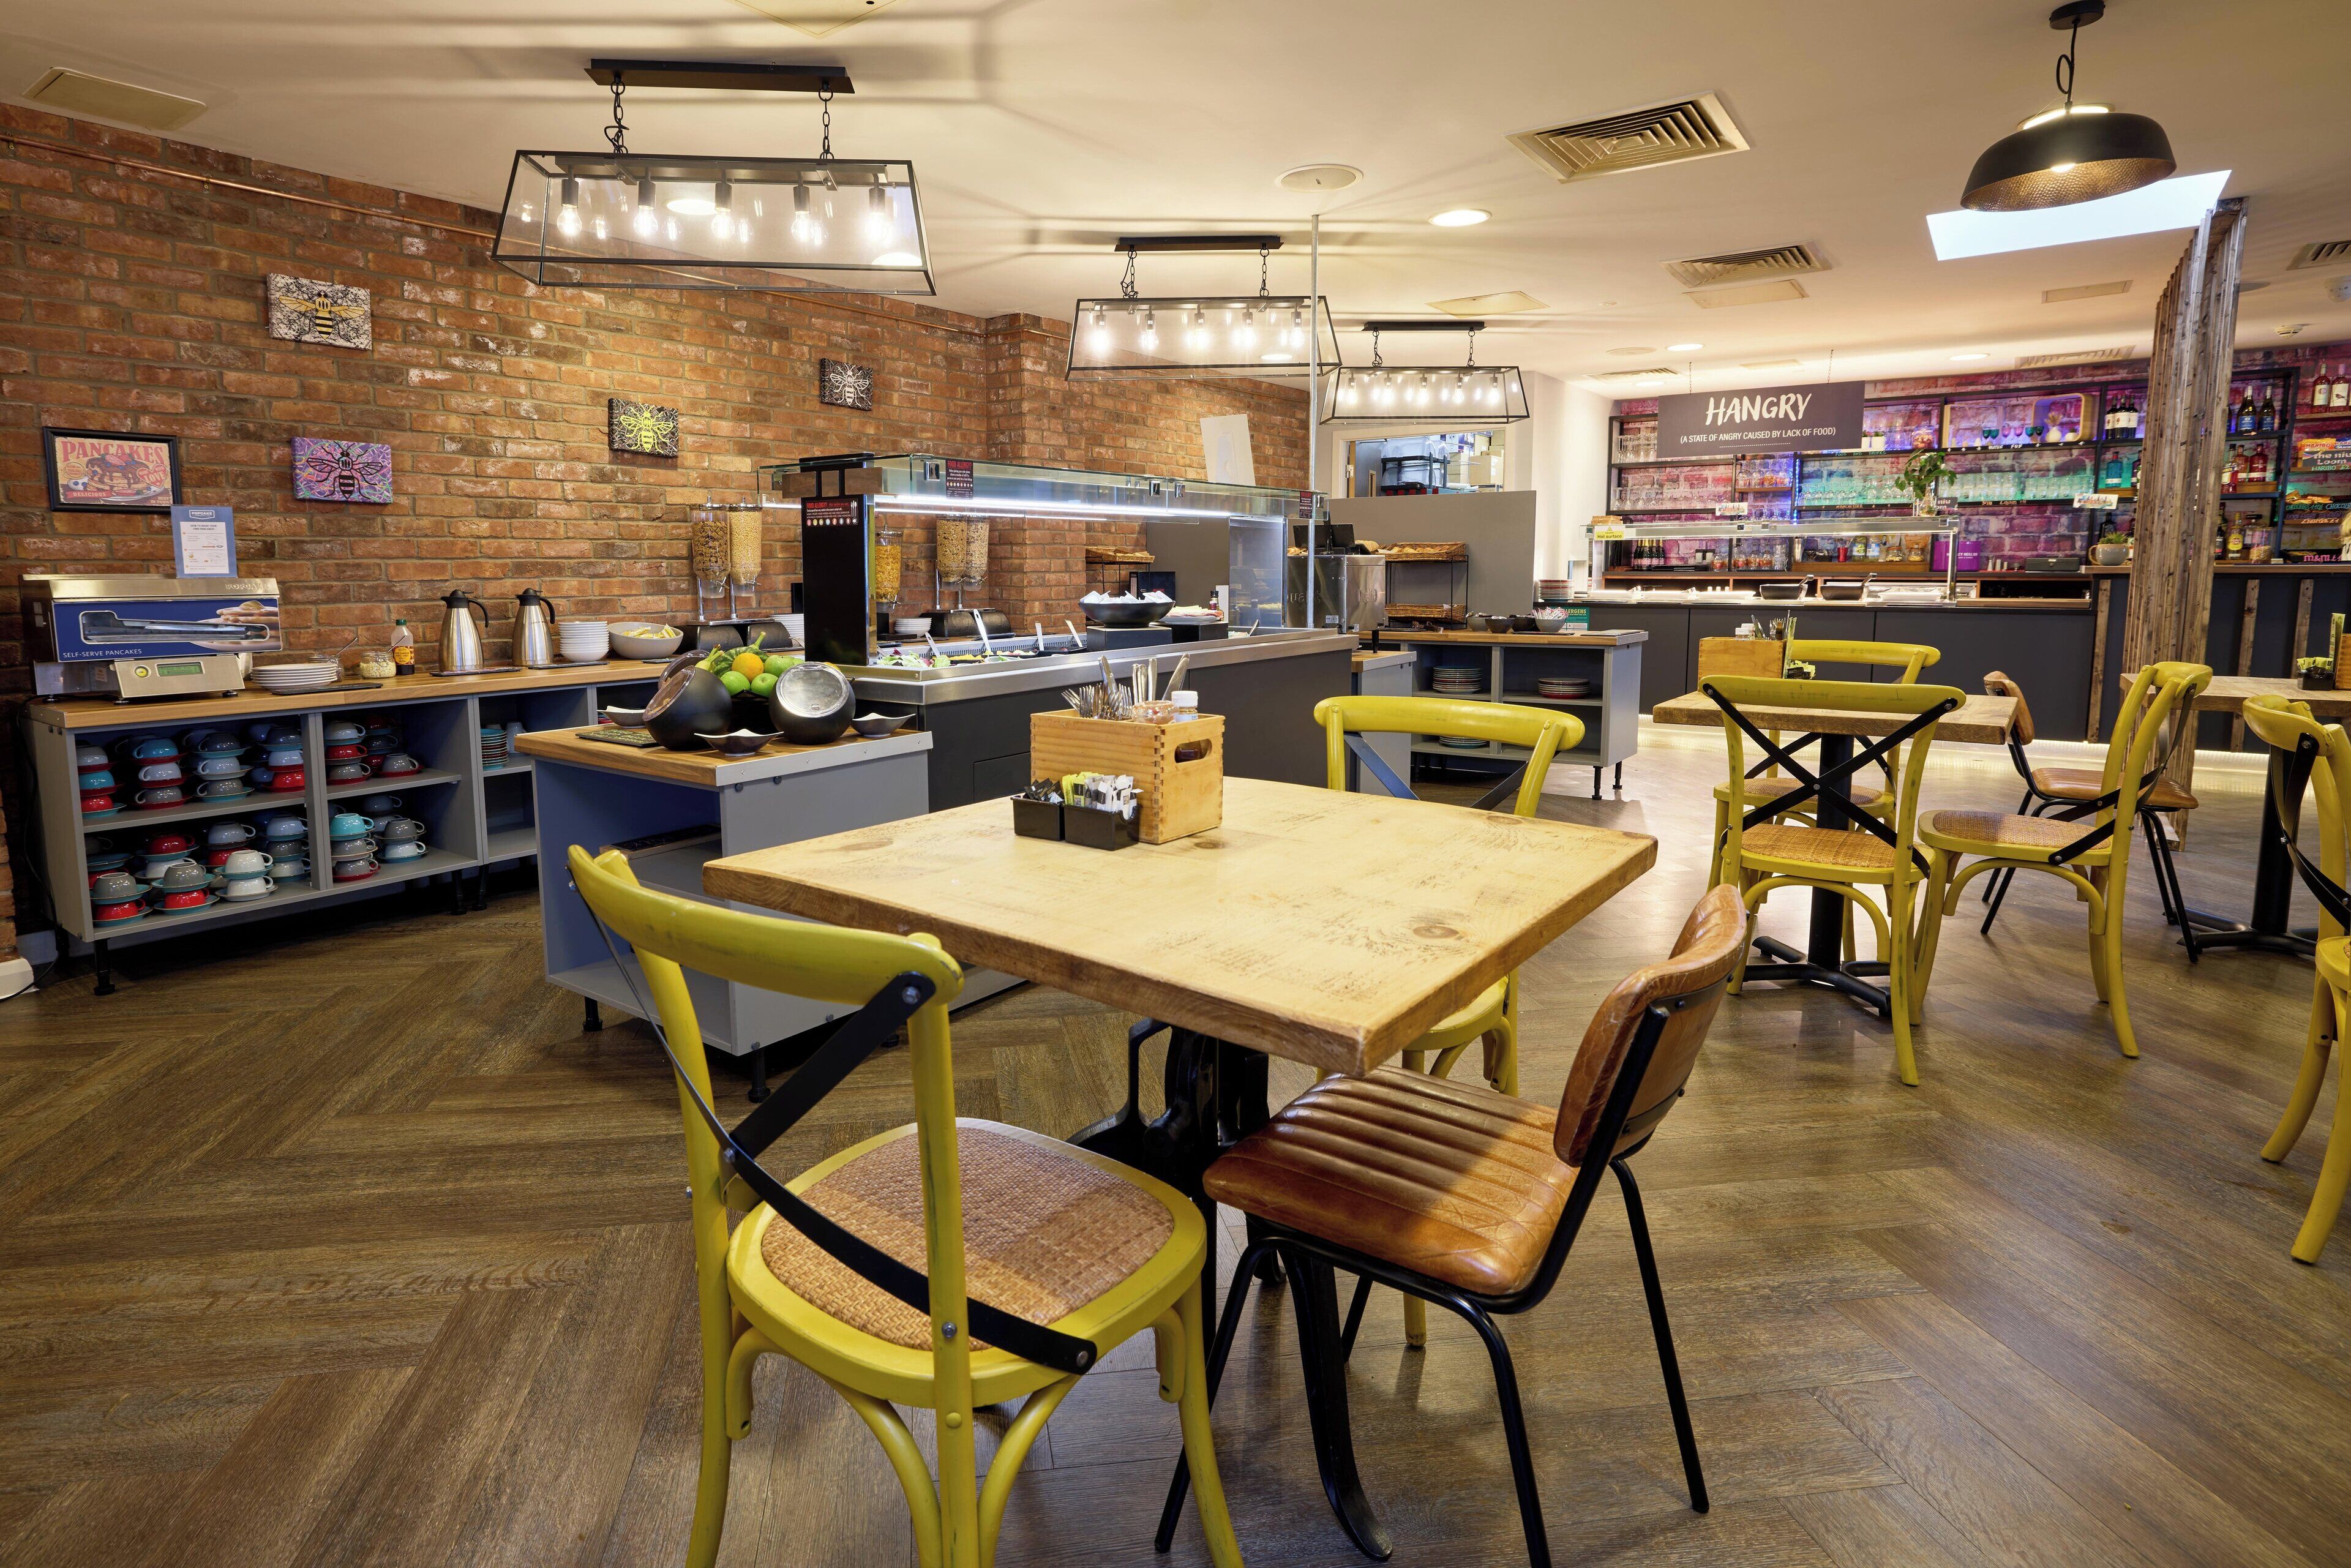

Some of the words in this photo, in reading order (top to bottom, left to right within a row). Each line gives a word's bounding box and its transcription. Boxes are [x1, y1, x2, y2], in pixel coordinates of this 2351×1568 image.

[1705, 393, 1812, 426] HANGRY
[1680, 435, 1688, 444] (A
[1689, 434, 1708, 443] STATE
[1719, 432, 1742, 441] ANGRY
[1743, 431, 1770, 440] CAUSED
[1782, 429, 1801, 437] LACK
[1813, 427, 1836, 435] FOOD)
[61, 440, 165, 465] PANCAKES
[144, 472, 165, 483] LOVE
